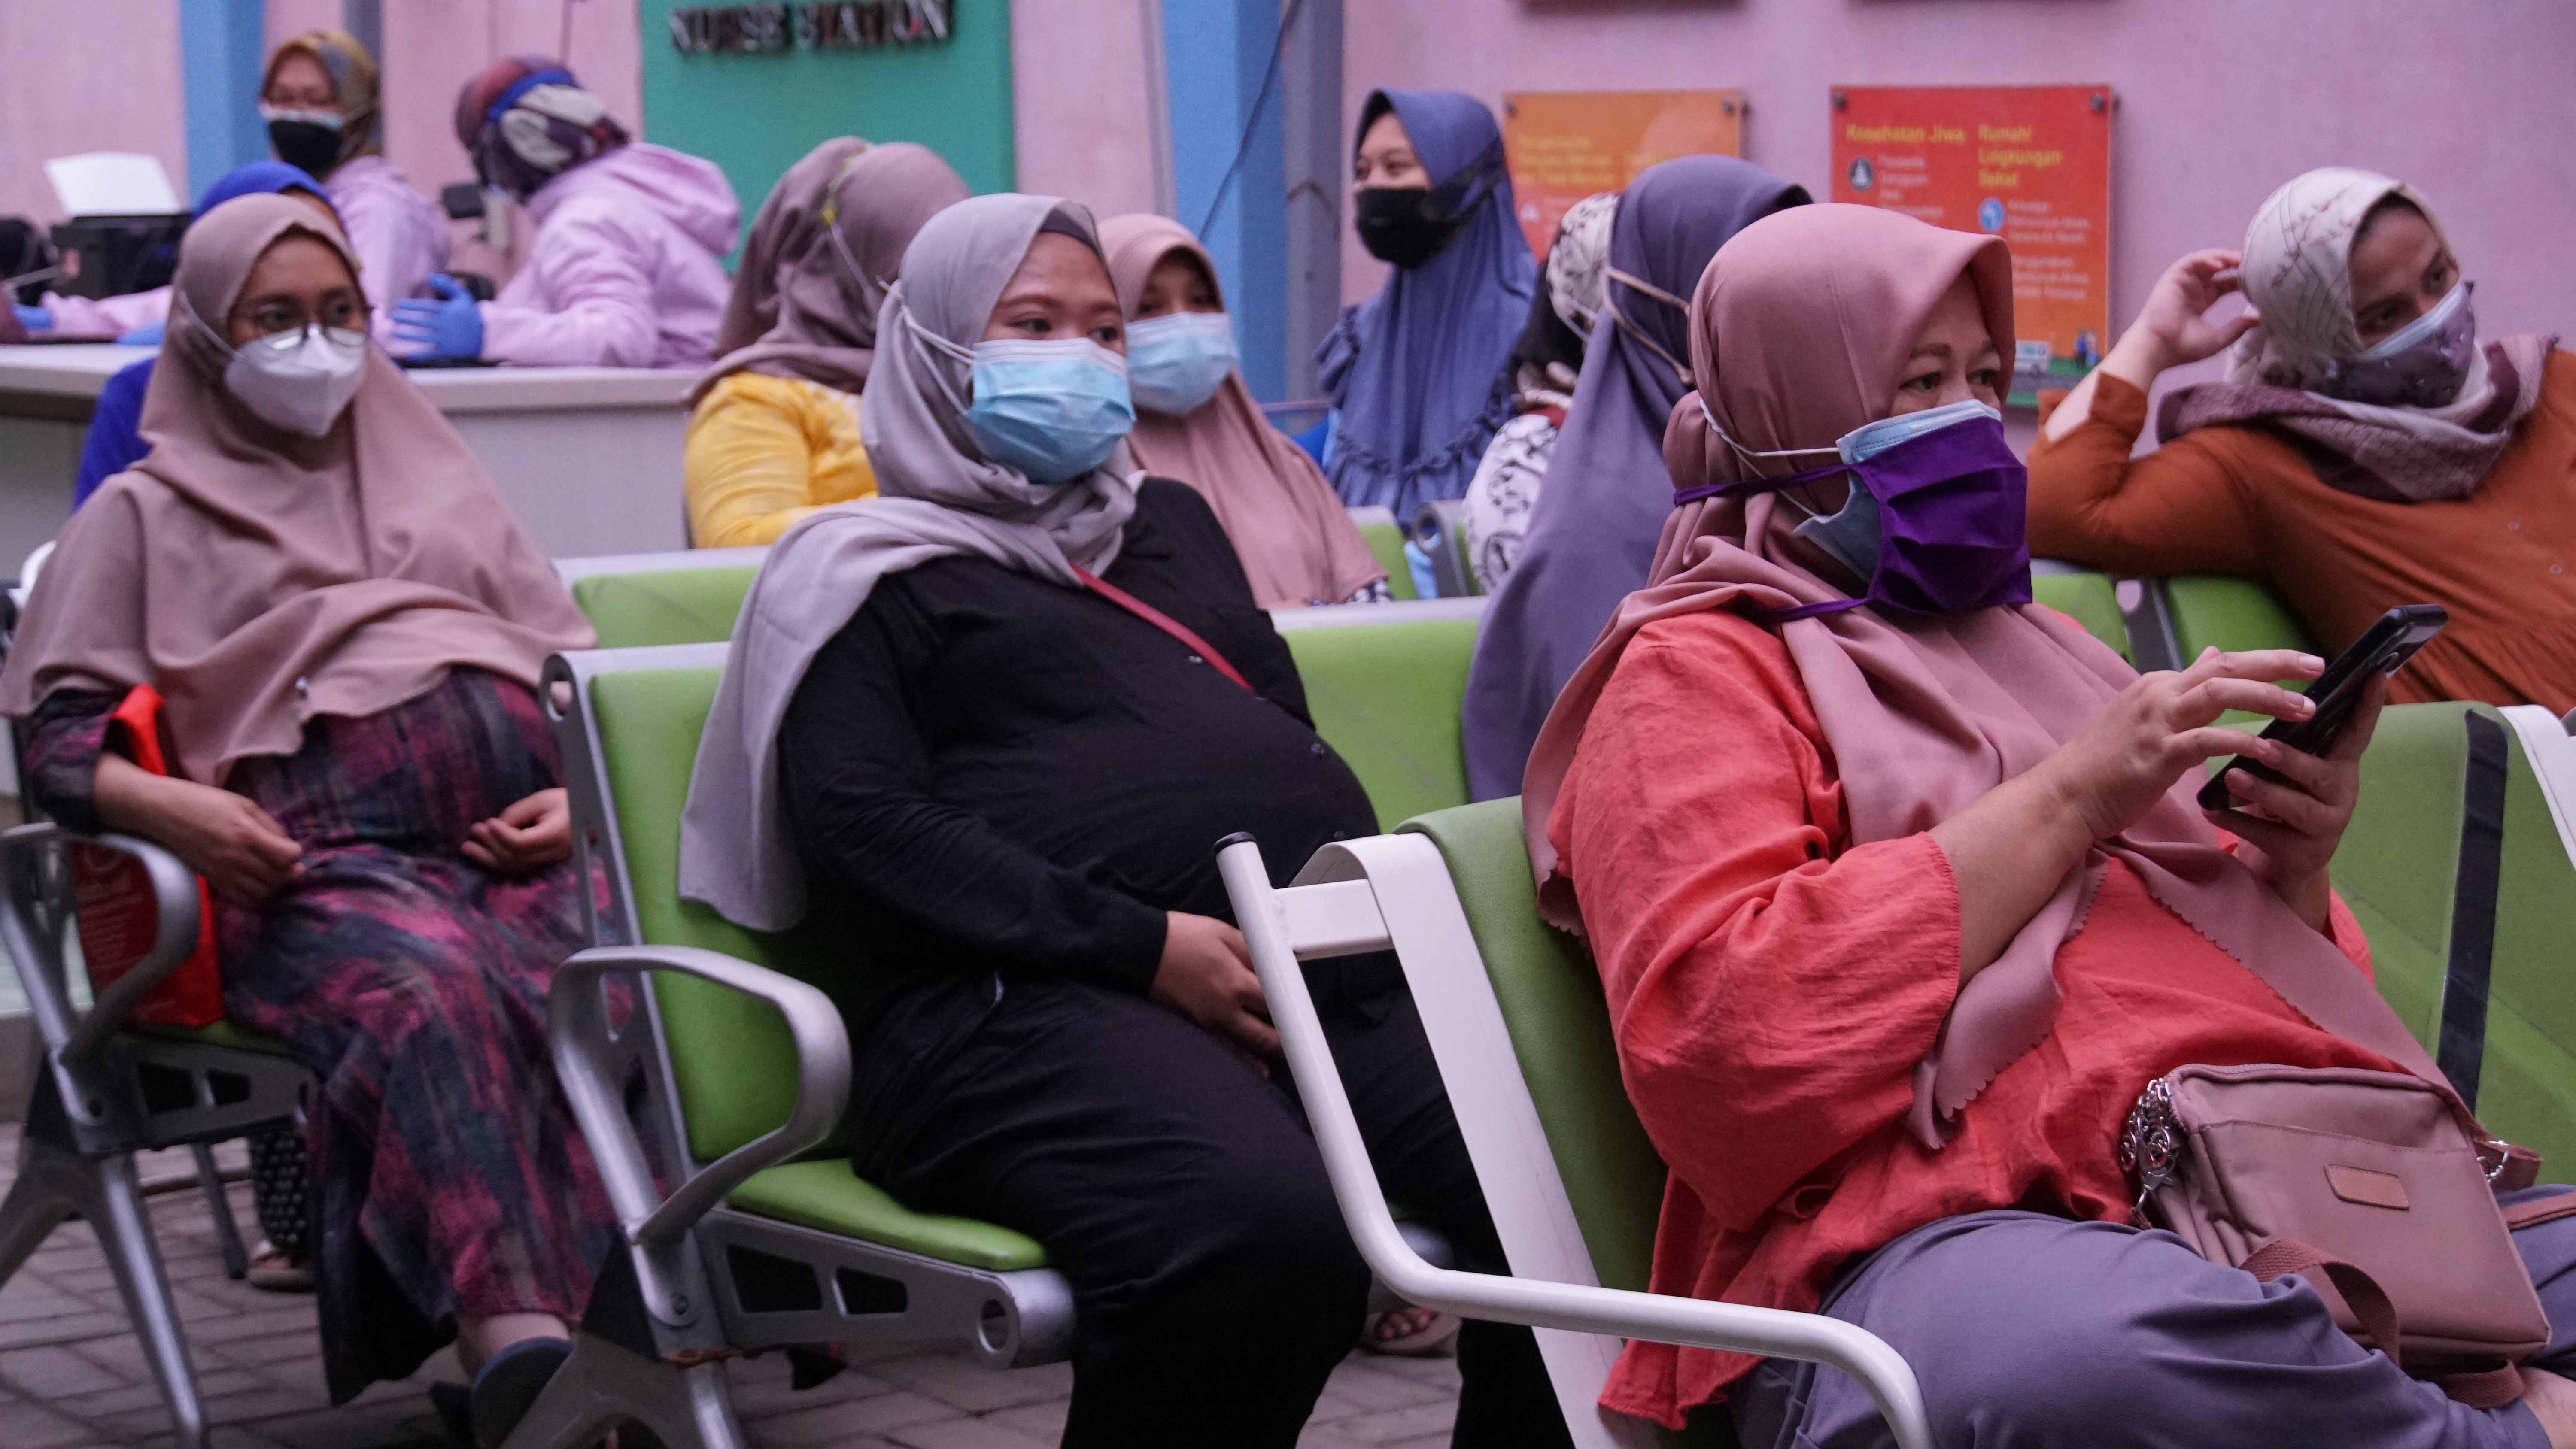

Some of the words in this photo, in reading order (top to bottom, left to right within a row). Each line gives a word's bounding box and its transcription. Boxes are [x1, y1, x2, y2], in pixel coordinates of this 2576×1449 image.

[669, 6, 789, 52] NURSE
[796, 0, 953, 47] STATION
[1846, 124, 1926, 142] Kesehatan
[1930, 124, 1965, 143] Jiwa
